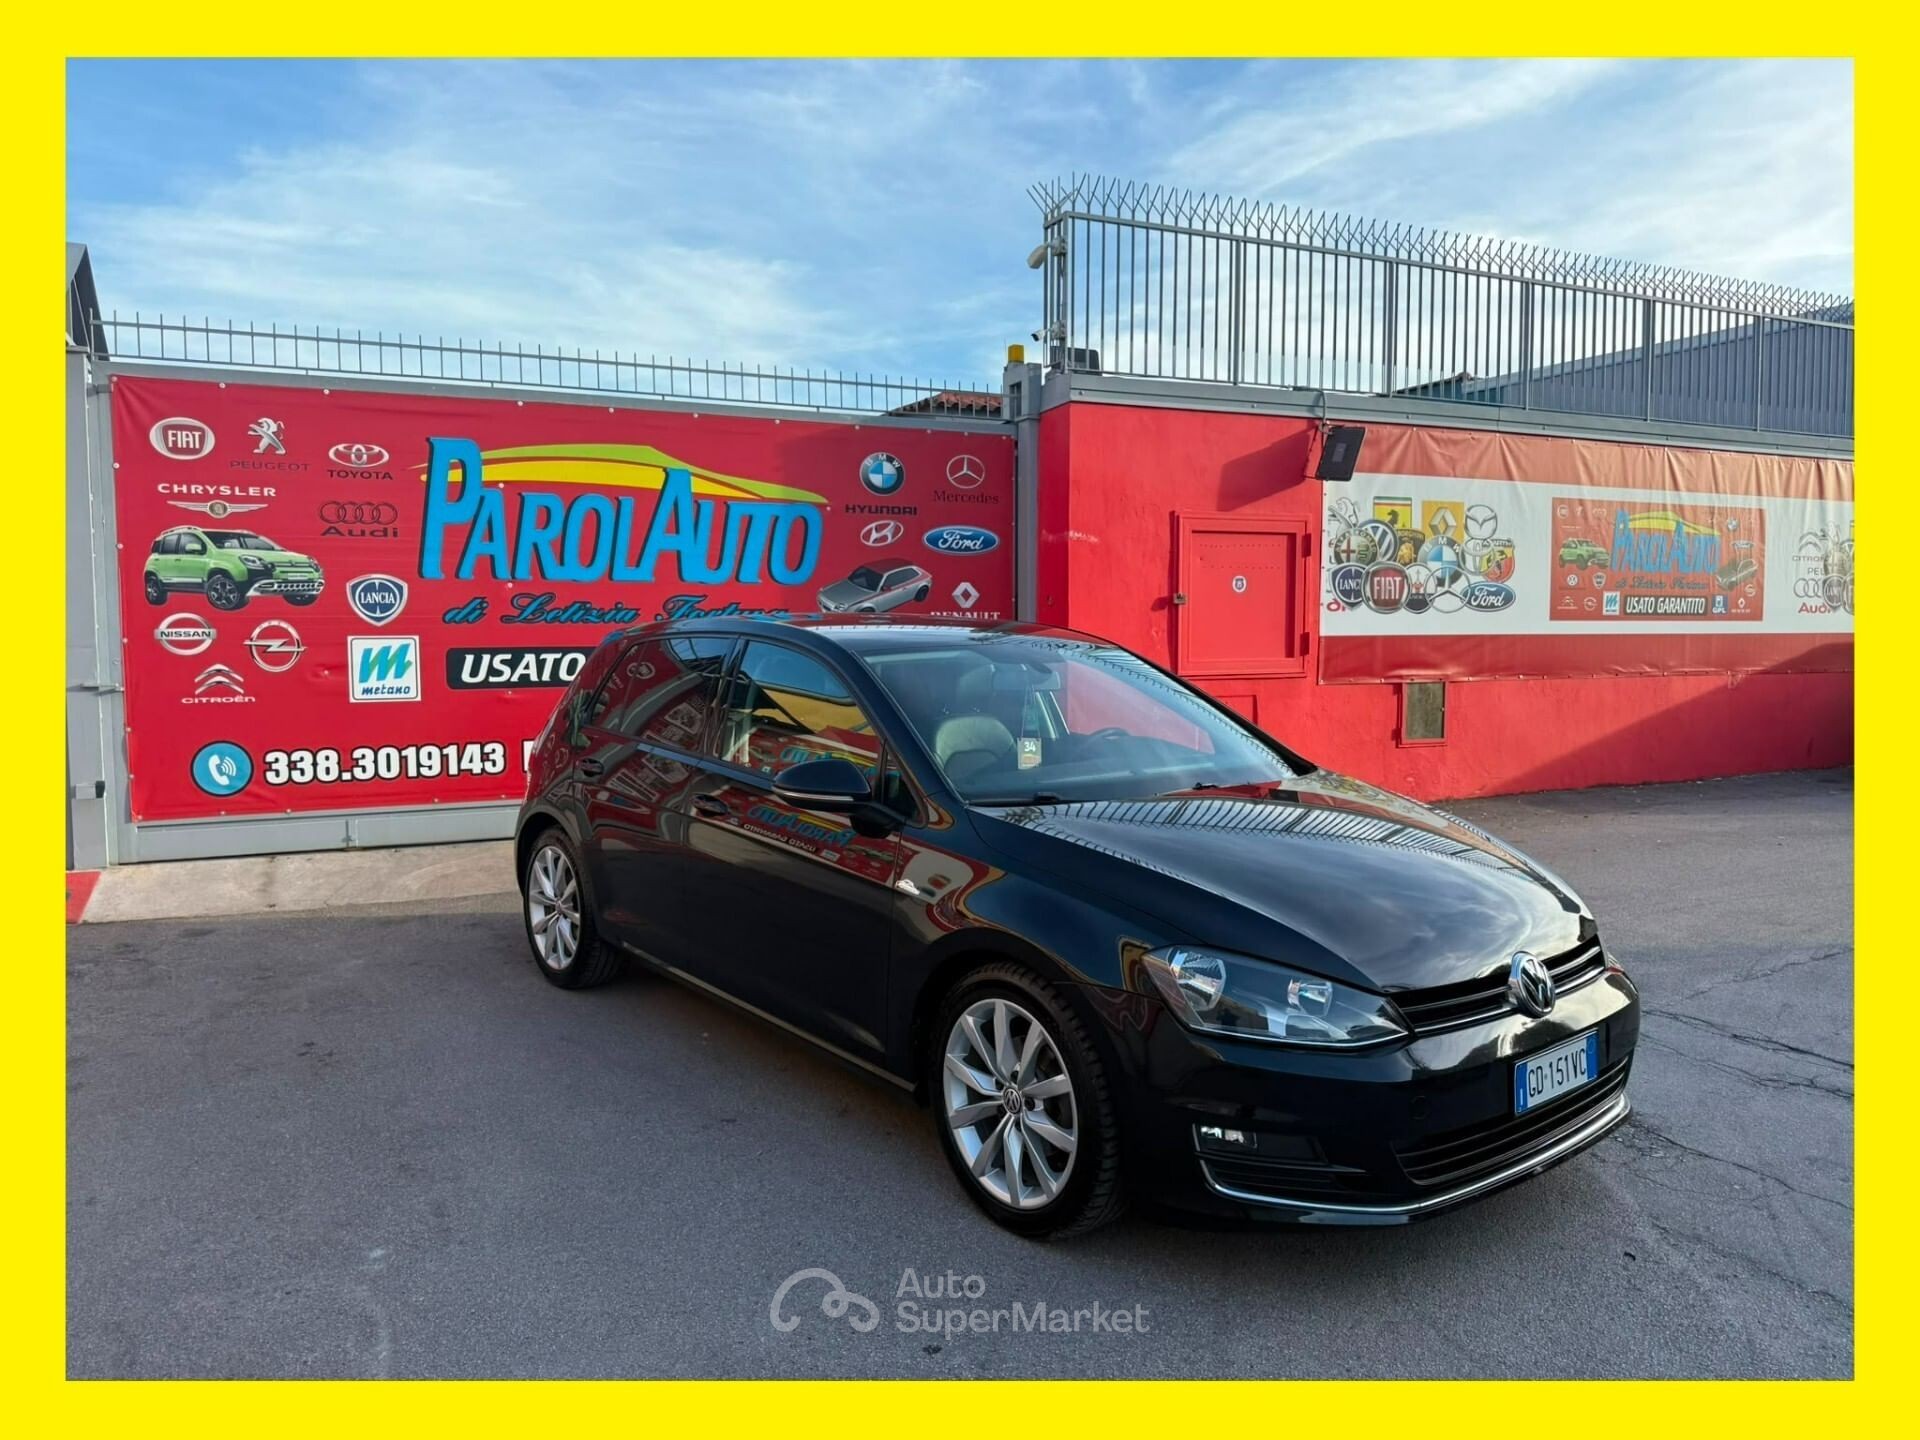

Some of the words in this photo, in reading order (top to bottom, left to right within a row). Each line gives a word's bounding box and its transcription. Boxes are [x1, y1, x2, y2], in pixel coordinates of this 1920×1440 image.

[167, 429, 203, 449] FIAT
[230, 459, 311, 472] PEUGEOT
[327, 468, 393, 481] TOYOTA
[157, 482, 277, 497] CHRYSLER
[933, 489, 1000, 505] Mercedes
[845, 503, 918, 516] HYUNDAI
[321, 526, 399, 538] Audi
[938, 528, 984, 551] Ford
[1339, 578, 1361, 591] LANC
[1373, 576, 1403, 601] FIAT
[360, 592, 396, 605] LANCIA
[1471, 585, 1505, 607] Ford
[444, 596, 489, 625] di
[1626, 596, 1655, 614] USATO
[1657, 598, 1706, 616] GARANTITO
[160, 630, 212, 638] NISSAN
[460, 652, 587, 684] USATO
[361, 684, 412, 696] metano
[1024, 741, 1036, 752] 34
[264, 742, 506, 786] 338.3019143
